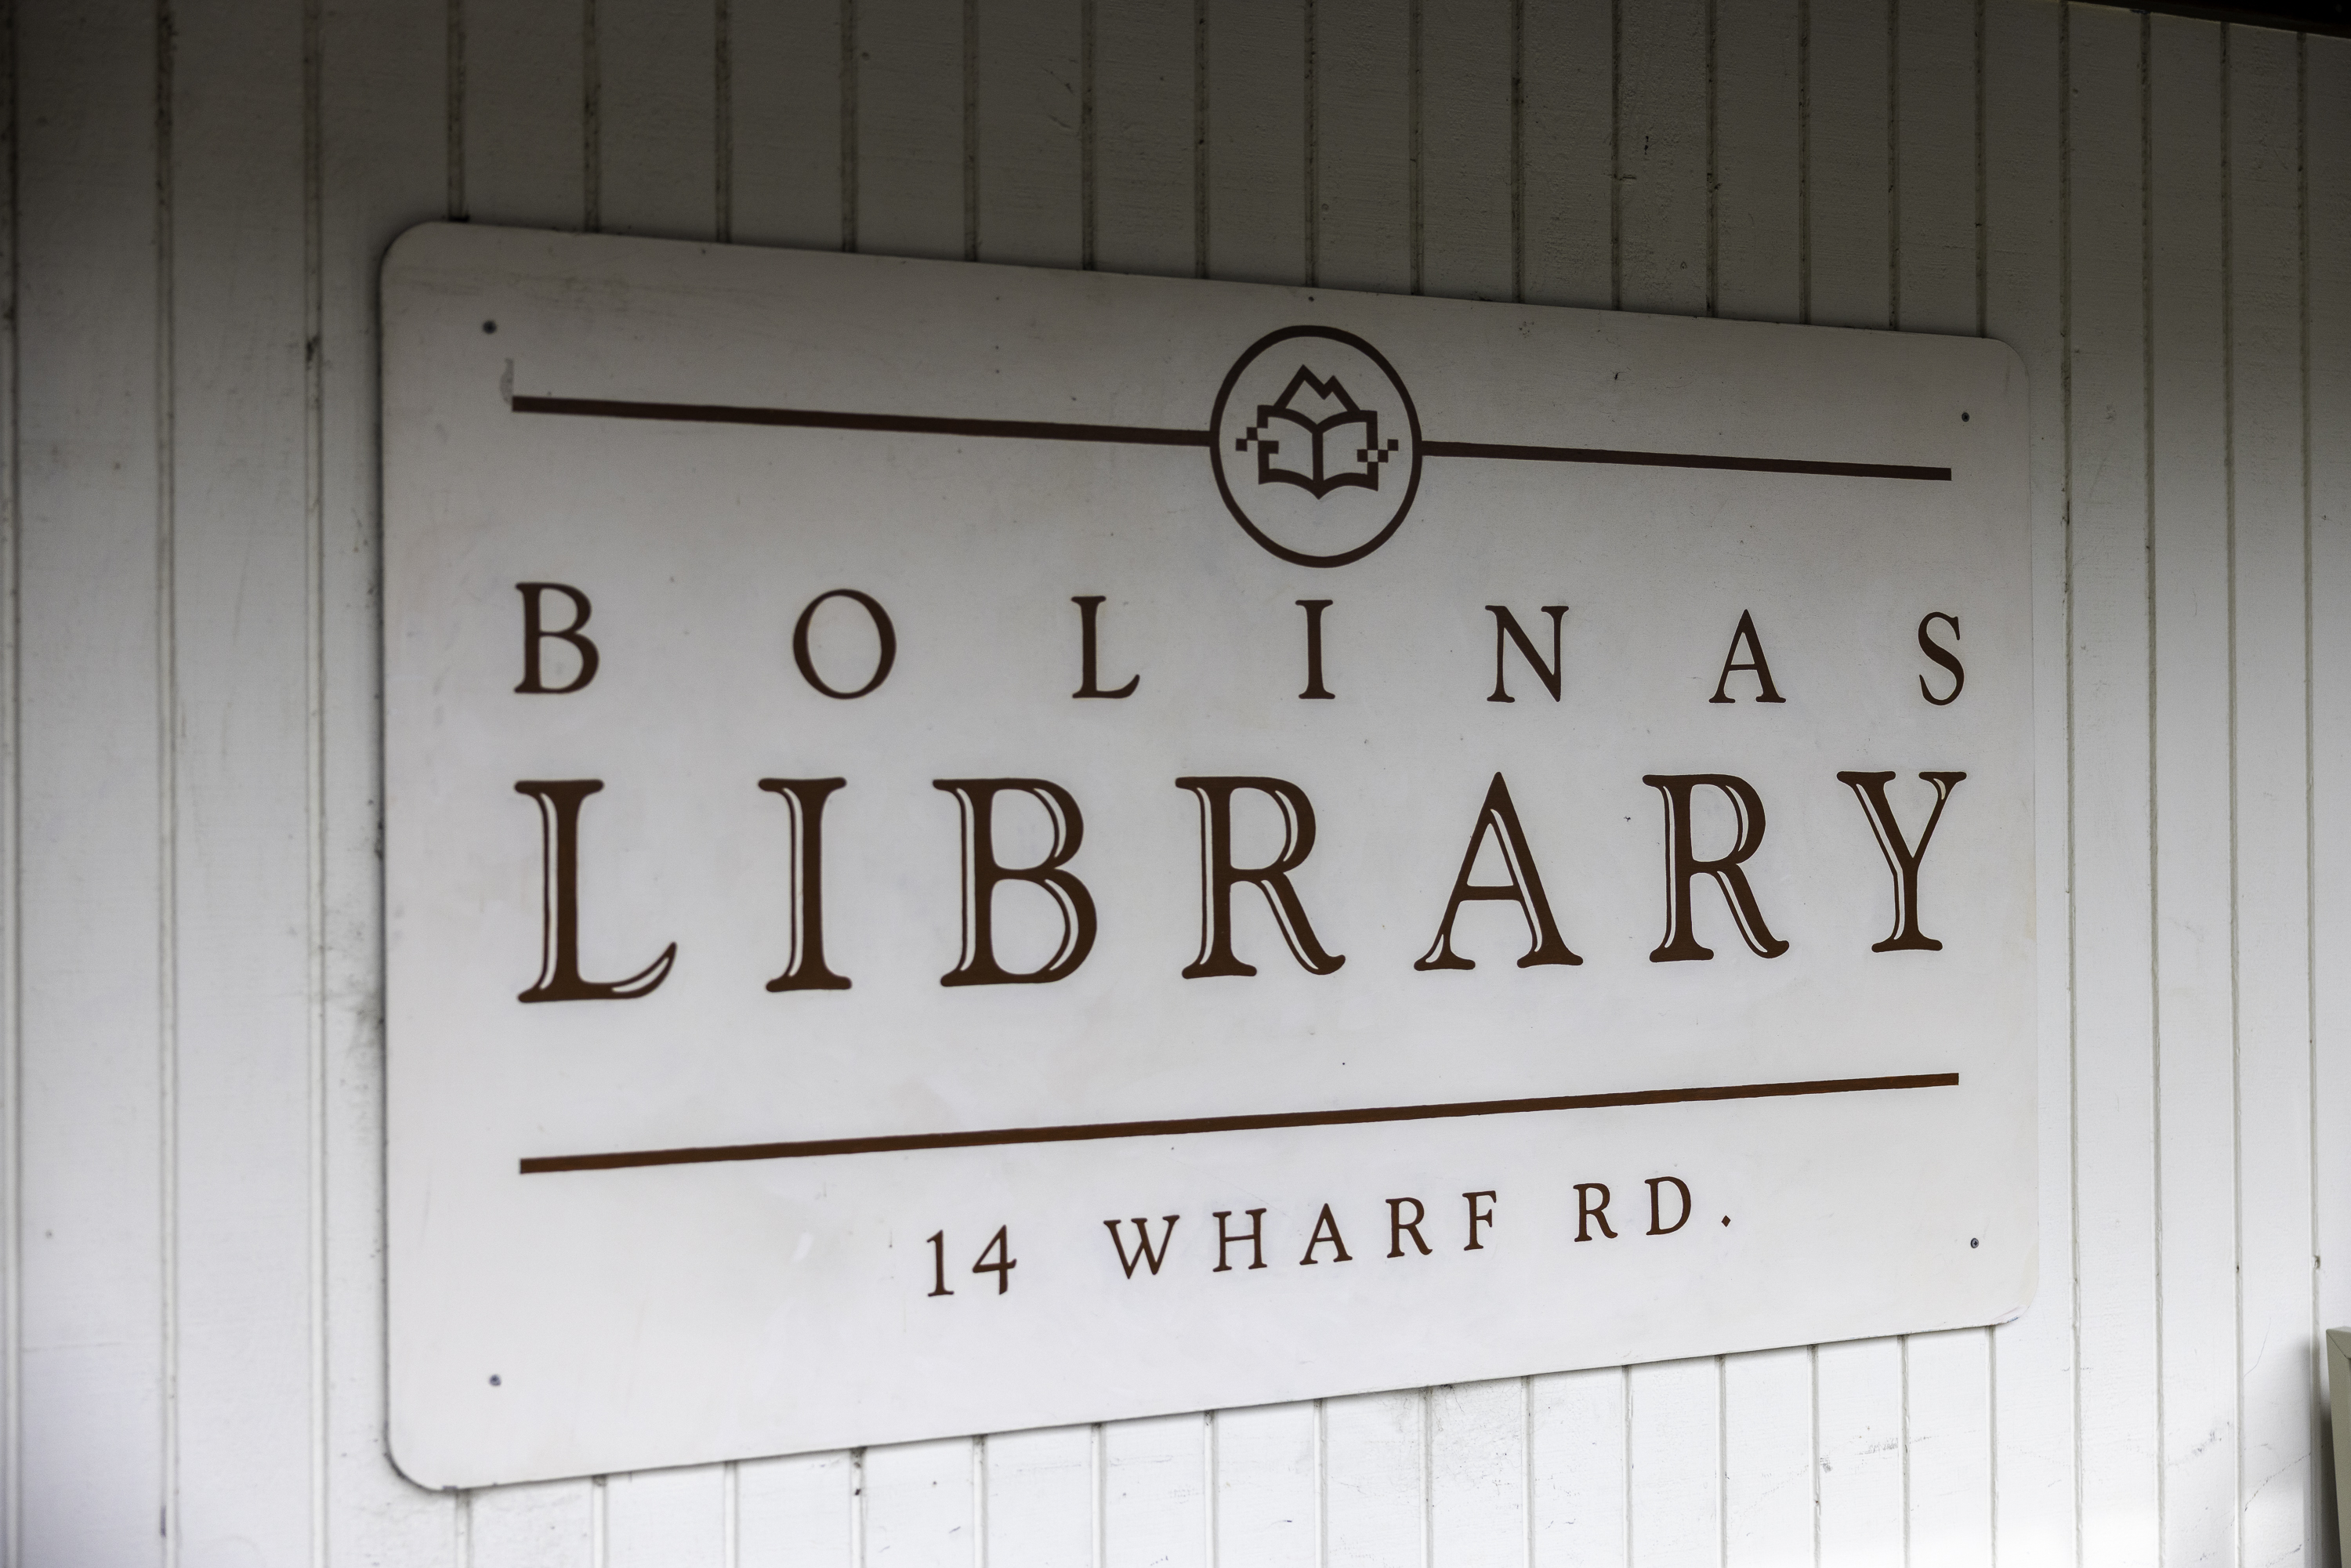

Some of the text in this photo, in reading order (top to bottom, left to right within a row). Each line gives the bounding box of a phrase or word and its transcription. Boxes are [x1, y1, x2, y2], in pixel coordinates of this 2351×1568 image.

[514, 581, 1965, 706] BOLINAS
[514, 771, 1968, 1004] LIBRARY
[926, 1175, 1731, 1298] 14 WHARF RD.
